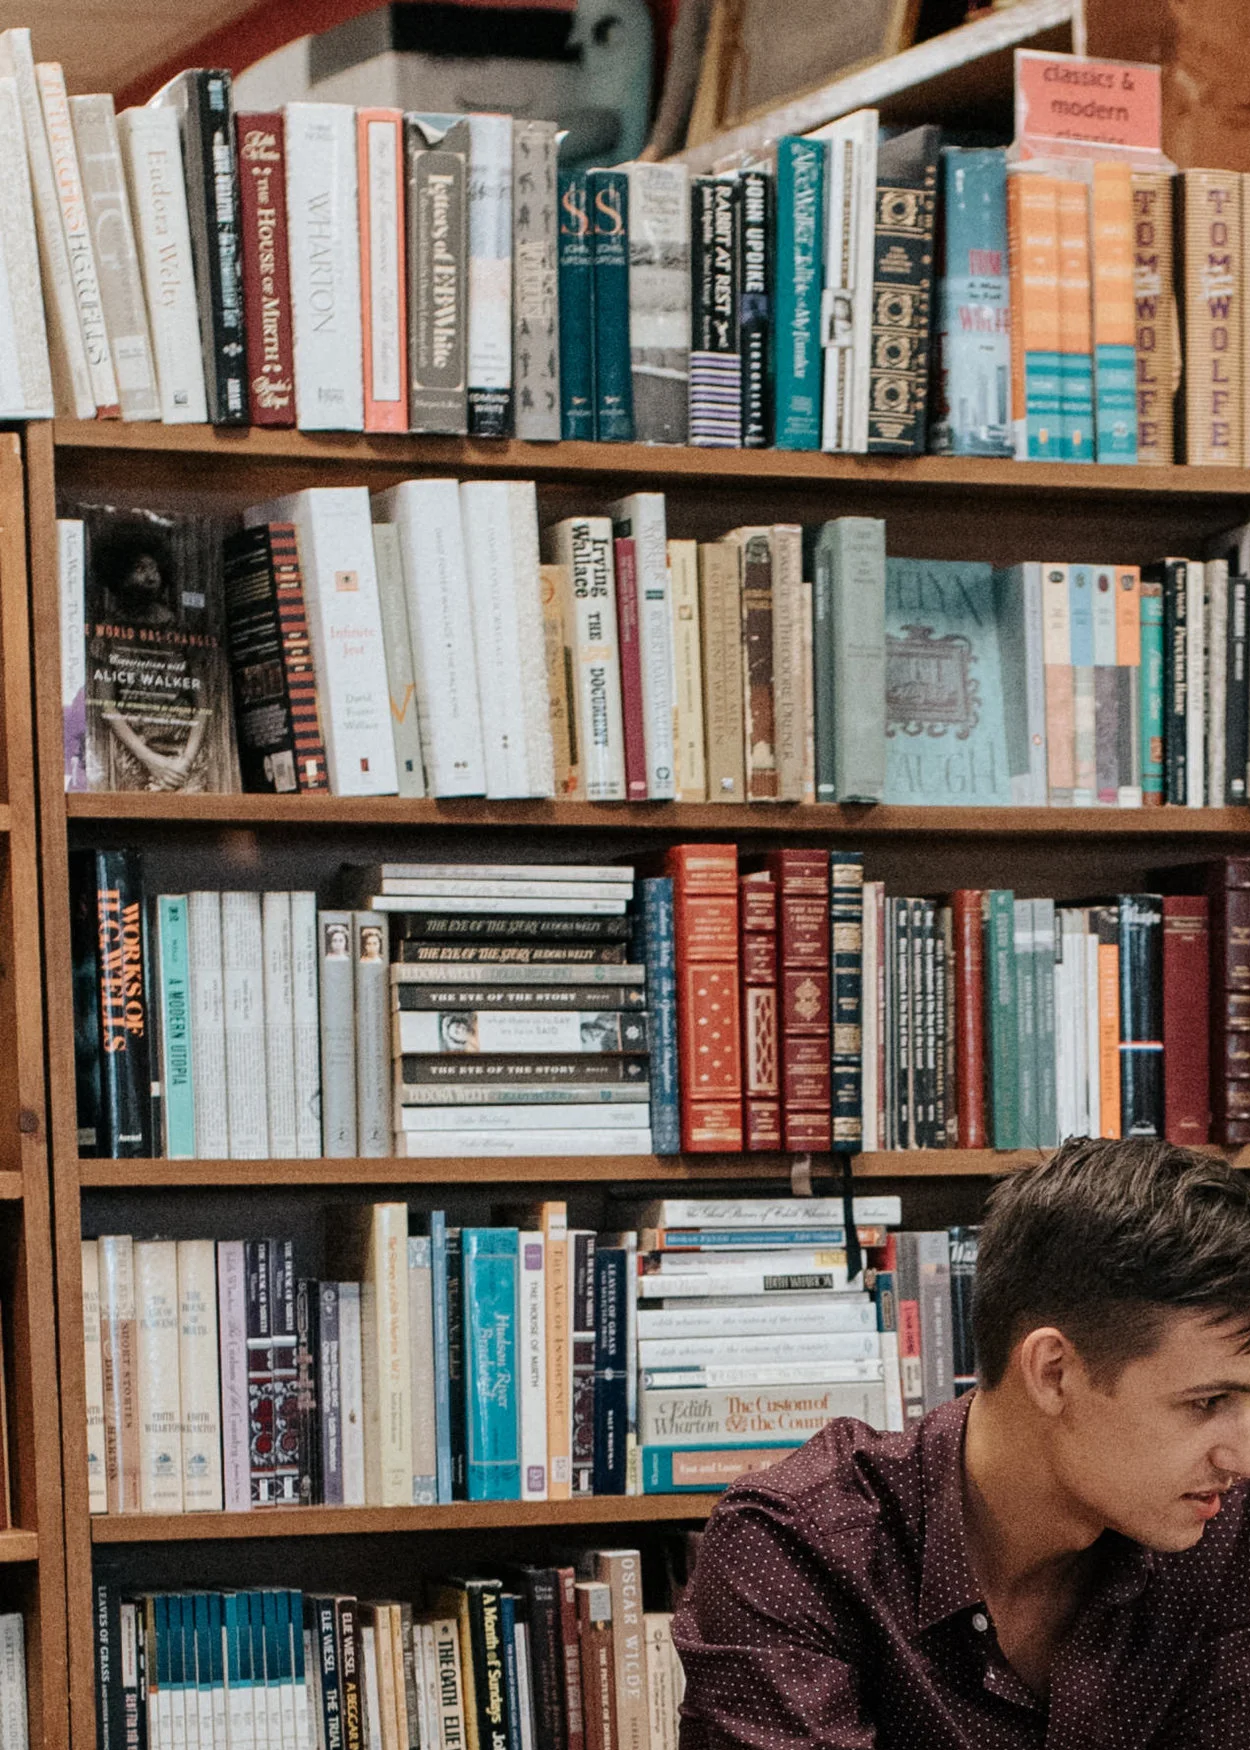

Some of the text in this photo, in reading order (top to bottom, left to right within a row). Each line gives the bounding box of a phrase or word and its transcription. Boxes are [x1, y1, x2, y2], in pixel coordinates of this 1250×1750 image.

[1043, 65, 1136, 91] classics &
[1050, 98, 1130, 122] modern
[146, 150, 181, 311] Eudora Welty
[745, 177, 765, 293] JOHN UPDIKE
[306, 191, 335, 334] WHARTON
[714, 185, 732, 316] RABBIT AT REST
[256, 179, 281, 361] THE HOUSE OF MIRTH
[1135, 297, 1158, 450] WOLFE
[1207, 298, 1232, 449] WOLFE
[570, 524, 591, 599] Wallace
[591, 537, 609, 598] Irving
[329, 626, 376, 640] Infinite
[588, 613, 601, 641] THE
[343, 643, 365, 657] Jest
[93, 669, 202, 690] ALICE WALKER
[590, 667, 609, 748] DOCUMENT
[120, 901, 144, 1038] WORKS OF
[418, 947, 438, 960] THE
[479, 947, 498, 960] THE
[499, 947, 533, 962] STORY
[429, 992, 456, 1002] THE
[459, 992, 484, 1002] EYE
[487, 992, 504, 1002] OF
[507, 992, 533, 1002] THE
[535, 992, 577, 1002] STORY
[168, 977, 188, 1086] A MODERN UTOPIA
[429, 1065, 456, 1074] THE
[459, 1065, 484, 1074] EYE
[487, 1065, 504, 1074] OF
[507, 1065, 533, 1074] THE
[535, 1065, 577, 1074] STORY
[258, 1243, 268, 1333] THE HOUSE OF MIRTH
[284, 1241, 295, 1331] THE HOUSE OF MIRTH
[585, 1257, 595, 1281] HOUSE
[585, 1282, 595, 1296] OF
[585, 1298, 595, 1326] MIRTH
[607, 1263, 617, 1356] LEAVES OF GRASS
[529, 1280, 541, 1388] THE HOUSE OF MIRTH
[553, 1248, 566, 1417] THE AGE OF INNOCENCE
[122, 1322, 132, 1429] SHORT STORIES
[478, 1327, 496, 1399] Bracketed
[493, 1311, 512, 1409] Hudson River
[659, 1400, 713, 1423] Edith
[726, 1394, 831, 1414] The Custom of
[655, 1416, 720, 1437] Wharton
[98, 1585, 109, 1626] LEAVES
[482, 1593, 494, 1604] A
[99, 1629, 110, 1645] OF
[320, 1610, 333, 1633] ELIE
[341, 1611, 354, 1635] ELIE
[484, 1607, 498, 1650] Month
[99, 1645, 111, 1683] GRASS
[322, 1635, 335, 1675] WIESEL
[343, 1636, 356, 1677] WIESEL
[438, 1638, 455, 1668] THE
[486, 1652, 499, 1667] of
[325, 1688, 339, 1712] THE
[345, 1682, 357, 1692] A
[439, 1669, 458, 1707] OATH
[485, 1668, 503, 1723] Sundays
[327, 1716, 341, 1750] TRIAL
[345, 1693, 359, 1740] BEGGAR
[443, 1715, 462, 1746] ELIE
